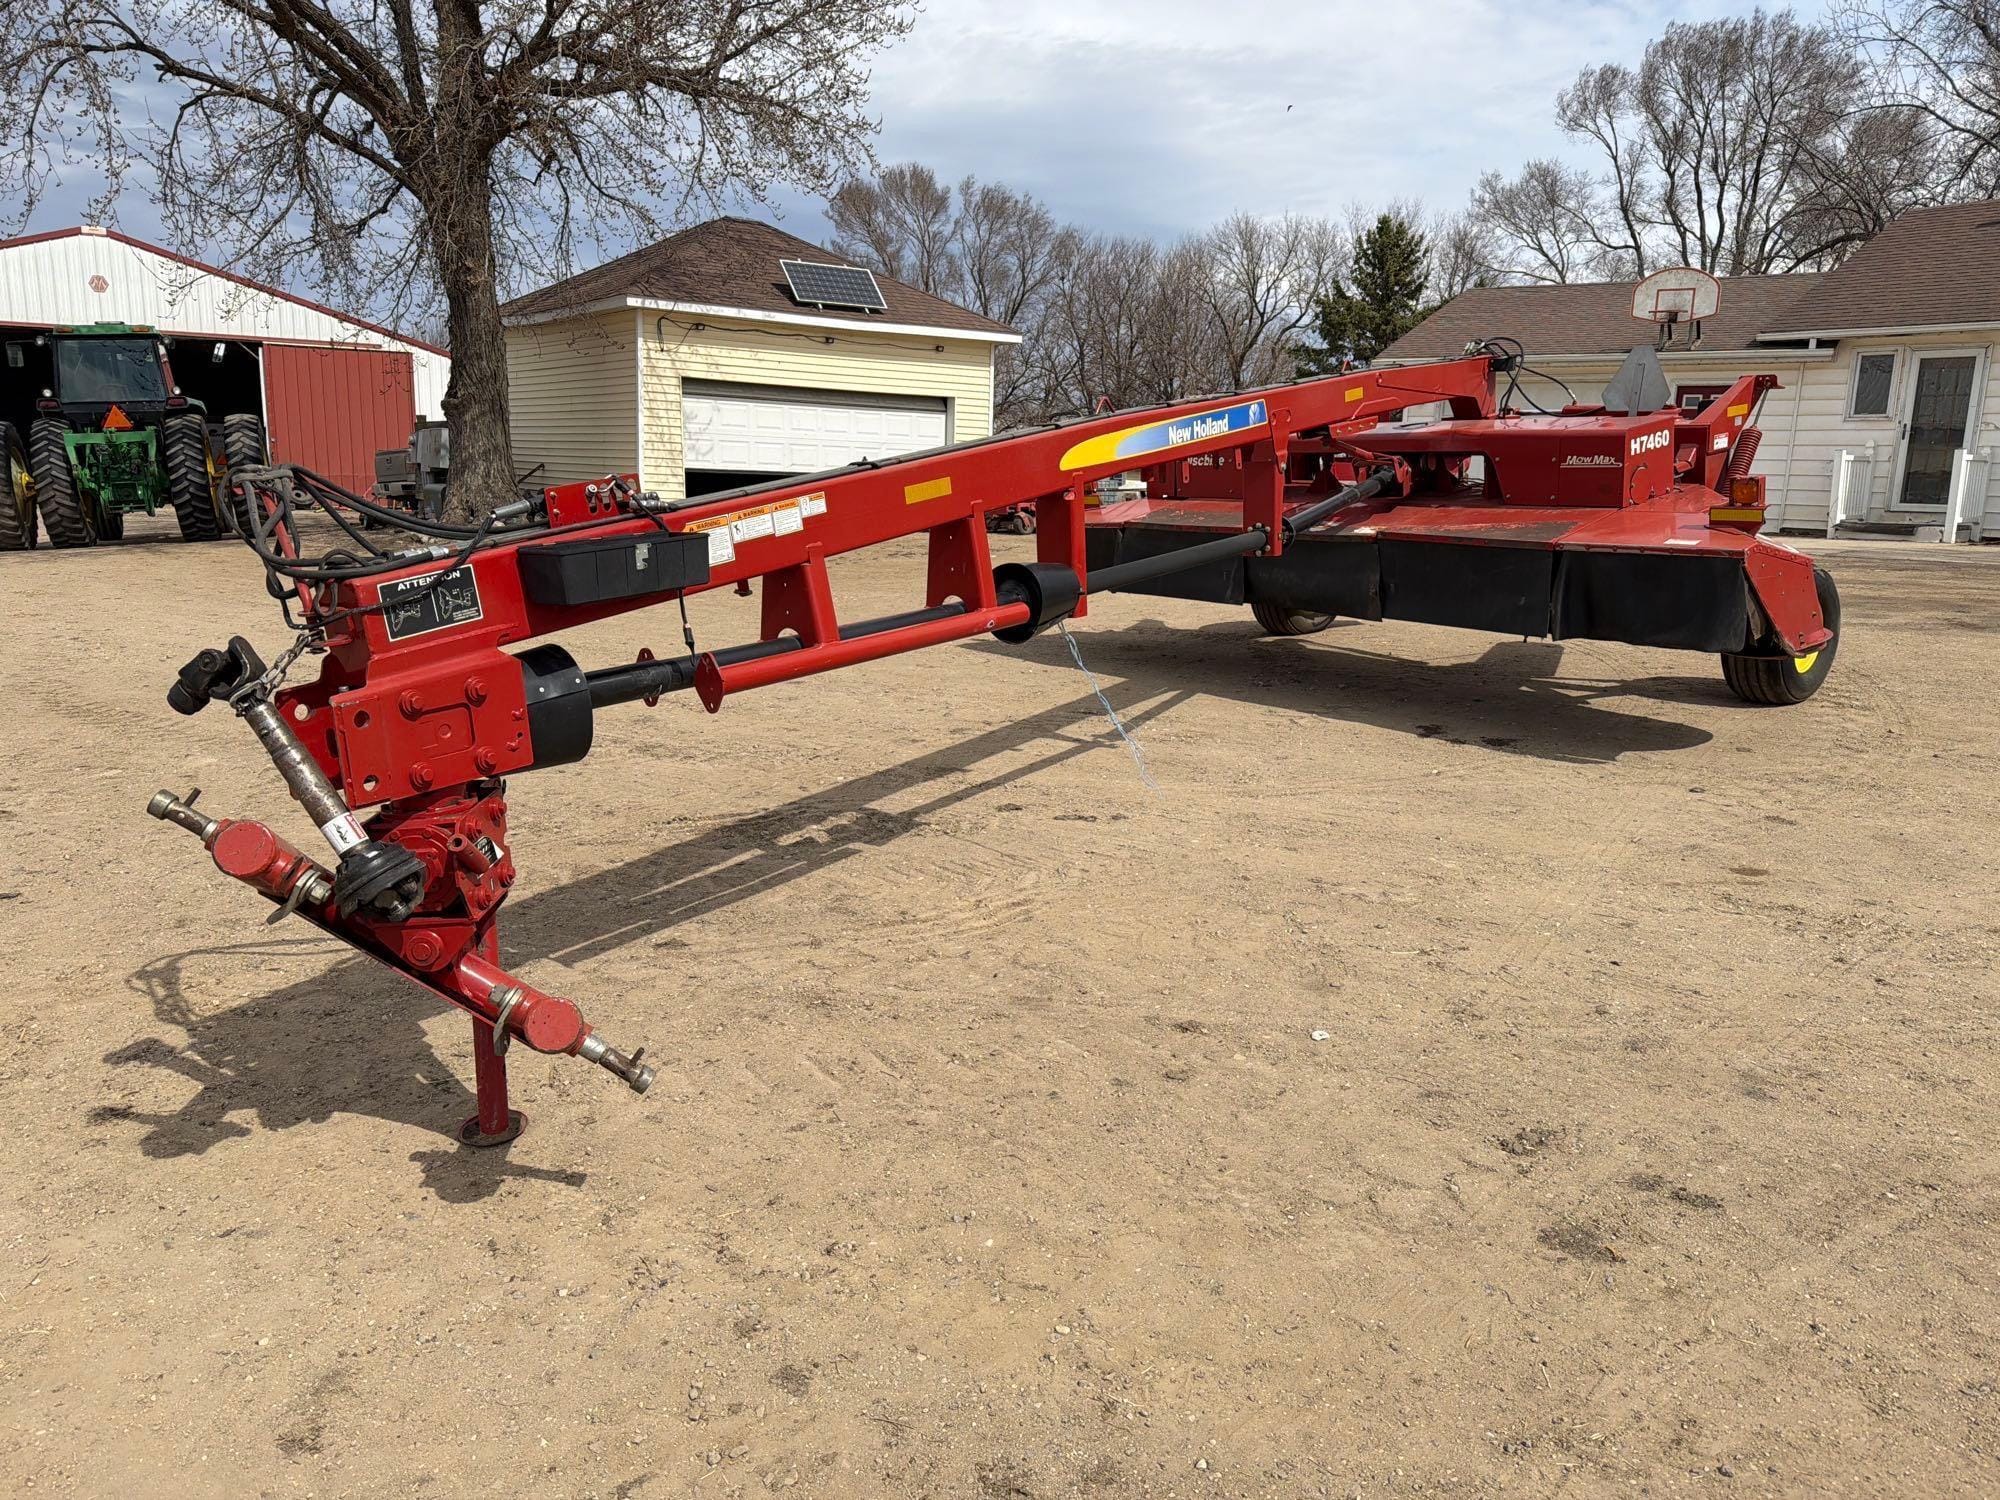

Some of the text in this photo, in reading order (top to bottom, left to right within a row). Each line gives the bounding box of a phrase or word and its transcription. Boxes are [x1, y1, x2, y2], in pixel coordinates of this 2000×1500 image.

[1168, 413, 1229, 445] New Holland
[1631, 429, 1670, 456] H7460
[743, 507, 765, 519] WARNING
[695, 519, 721, 530] WARNING
